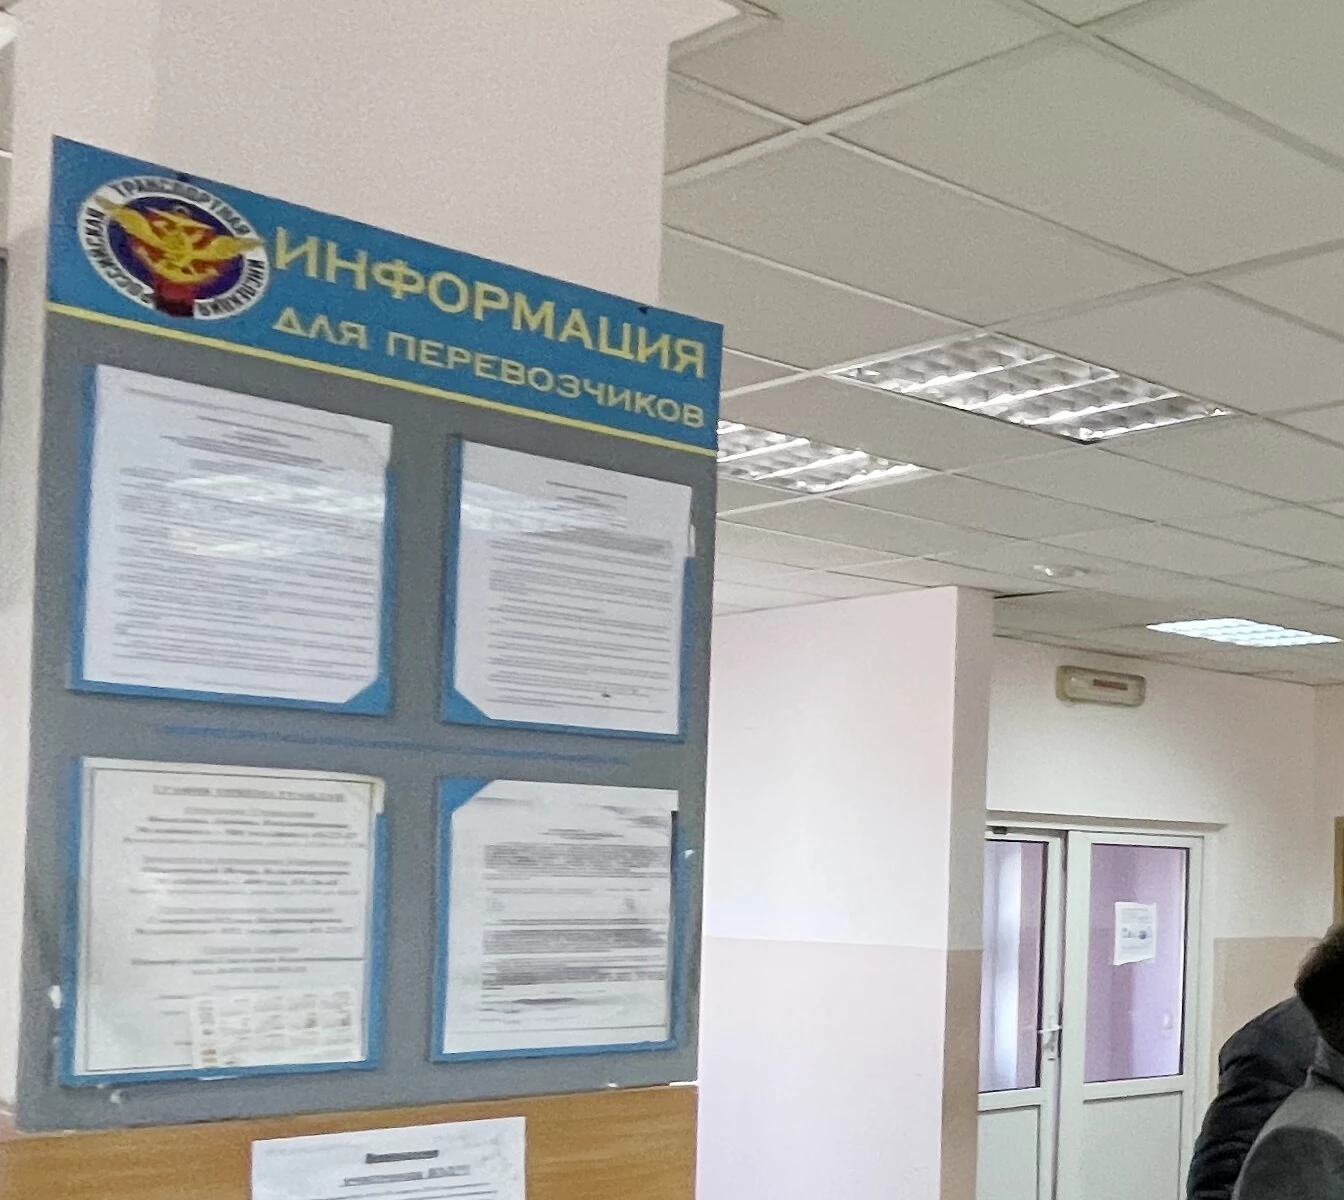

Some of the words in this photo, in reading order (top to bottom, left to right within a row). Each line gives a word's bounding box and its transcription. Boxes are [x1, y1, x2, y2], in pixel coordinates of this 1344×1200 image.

[272, 306, 368, 350] ДЛЯ
[386, 331, 705, 429] ПЕРЕВОЗЧИКОВ
[274, 226, 706, 378] ИНФОРМАЦИЯ
